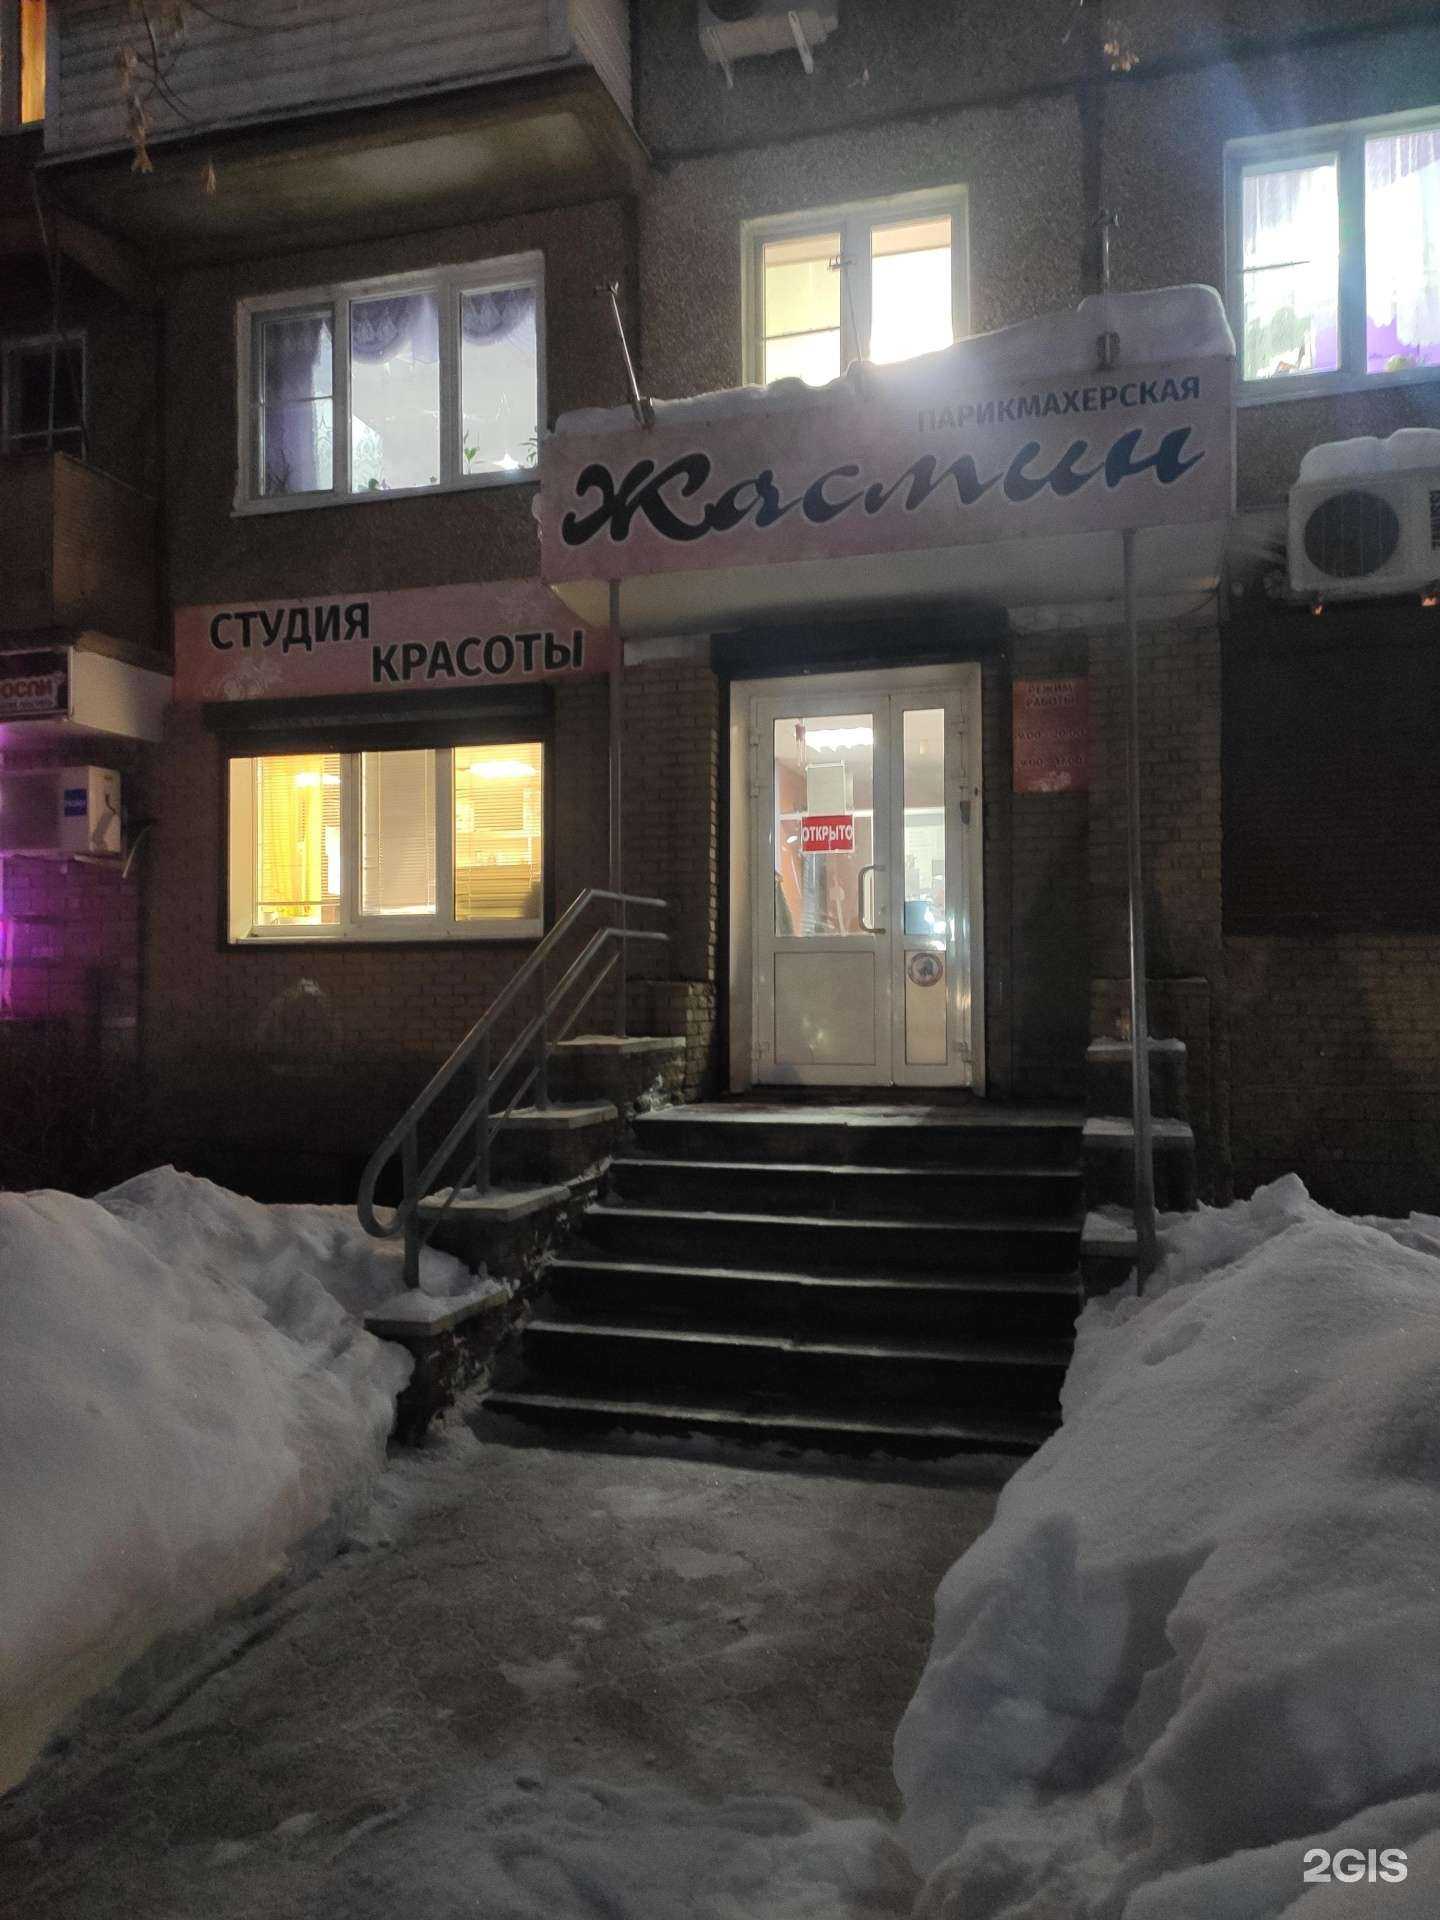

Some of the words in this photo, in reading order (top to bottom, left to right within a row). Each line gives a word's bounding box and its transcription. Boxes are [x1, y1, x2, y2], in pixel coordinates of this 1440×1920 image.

[918, 377, 1200, 433] ПАРИКМАХЕРСКАЯ
[562, 426, 1205, 546] Жасмин
[210, 602, 370, 654] СТУДИЯ
[372, 631, 584, 683] КРАСОТЫ
[802, 824, 853, 841] ОТКРЫТО
